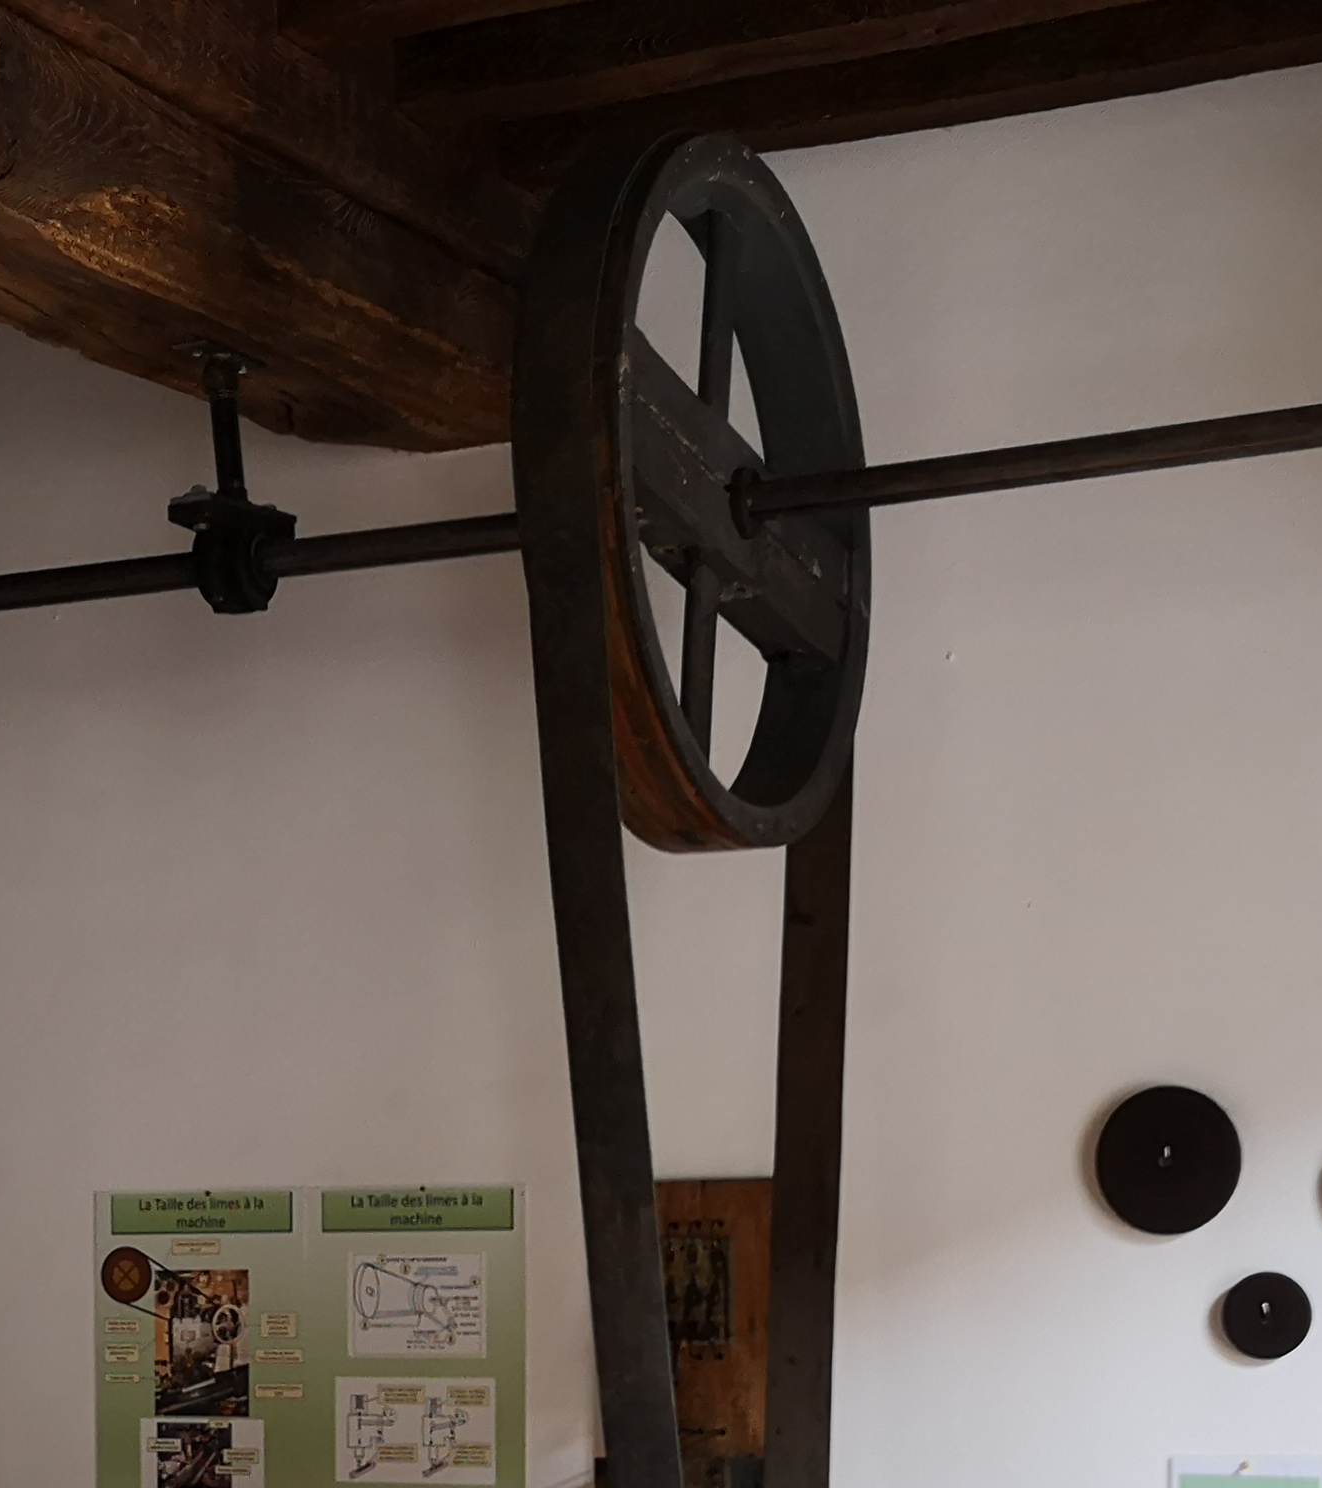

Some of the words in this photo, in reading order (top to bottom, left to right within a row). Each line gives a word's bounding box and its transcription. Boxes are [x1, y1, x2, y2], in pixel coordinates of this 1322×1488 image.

[139, 1199, 152, 1211] La
[156, 1199, 183, 1211] Taille
[187, 1198, 206, 1210] des
[210, 1199, 240, 1209] limes
[244, 1197, 250, 1209] à
[254, 1197, 264, 1209] la
[351, 1195, 364, 1208] La
[367, 1194, 398, 1208] Taille
[401, 1194, 423, 1208] des
[425, 1194, 458, 1207] limes
[461, 1193, 468, 1206] à
[472, 1193, 483, 1206] la
[177, 1216, 226, 1228] machine
[390, 1213, 443, 1225] machine
